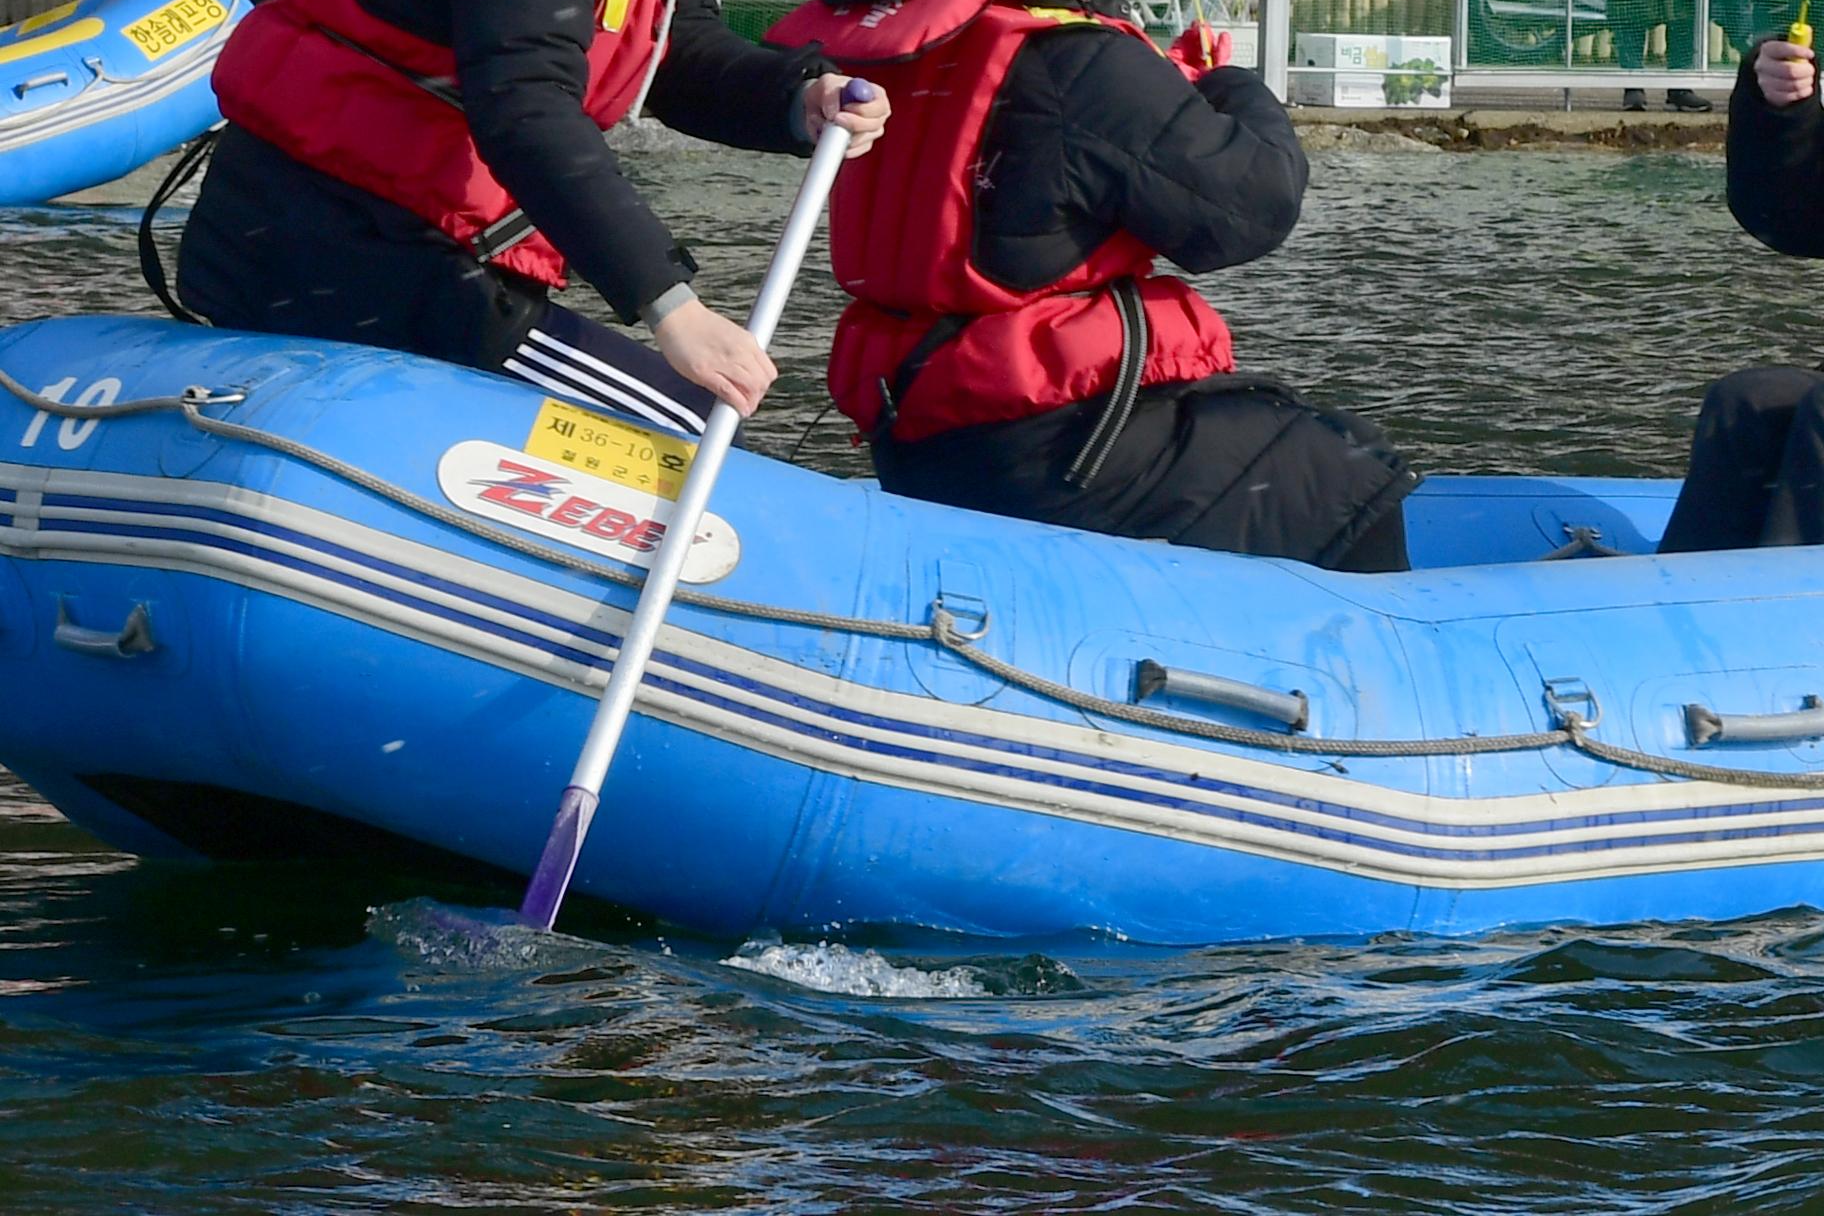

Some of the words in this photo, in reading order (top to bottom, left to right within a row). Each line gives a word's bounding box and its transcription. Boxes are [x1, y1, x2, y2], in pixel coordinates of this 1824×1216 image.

[20, 376, 123, 451] 10
[546, 416, 577, 439] 제
[579, 427, 655, 463] 36-10
[657, 451, 687, 474] 호
[468, 459, 708, 554] ZEBE
